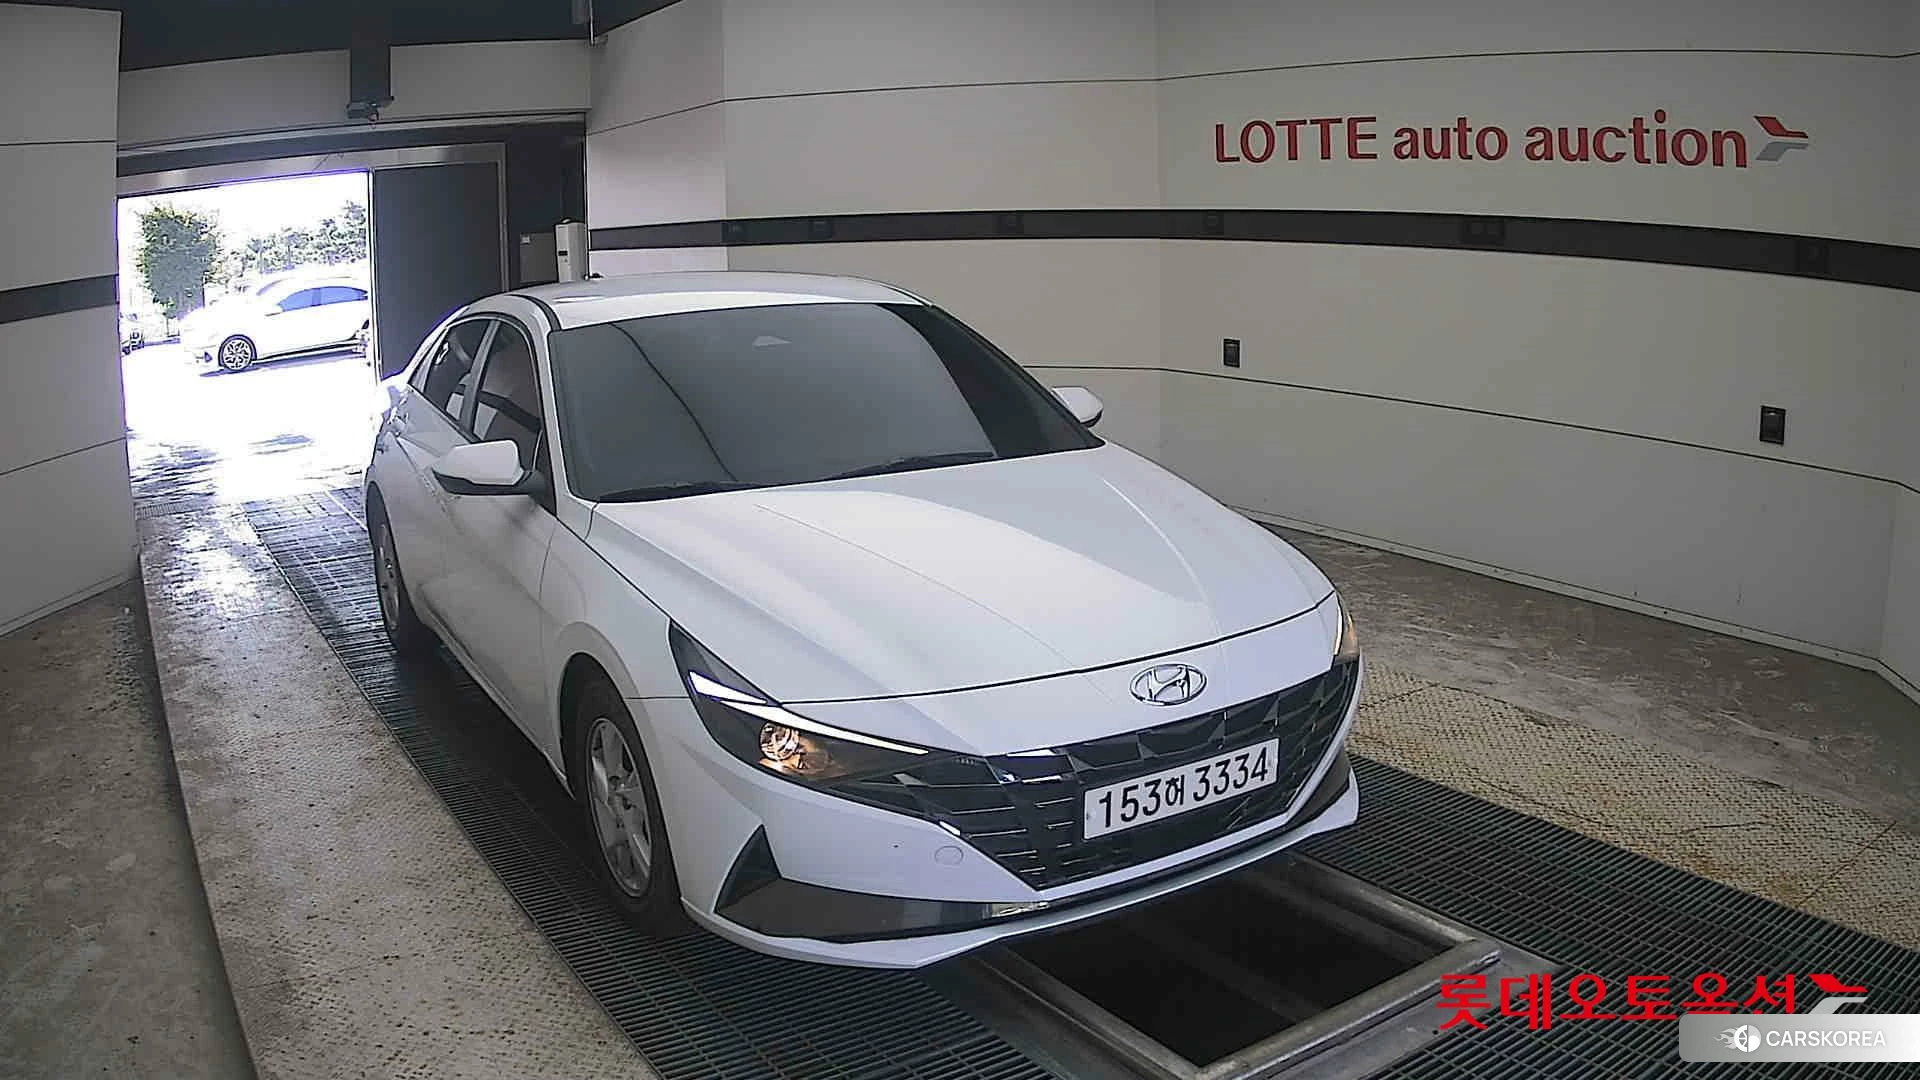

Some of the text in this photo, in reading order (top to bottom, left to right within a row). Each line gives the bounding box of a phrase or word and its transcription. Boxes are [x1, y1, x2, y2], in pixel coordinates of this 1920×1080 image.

[1214, 108, 1748, 169] LOTTE auto auction
[1193, 746, 1268, 802] 3334
